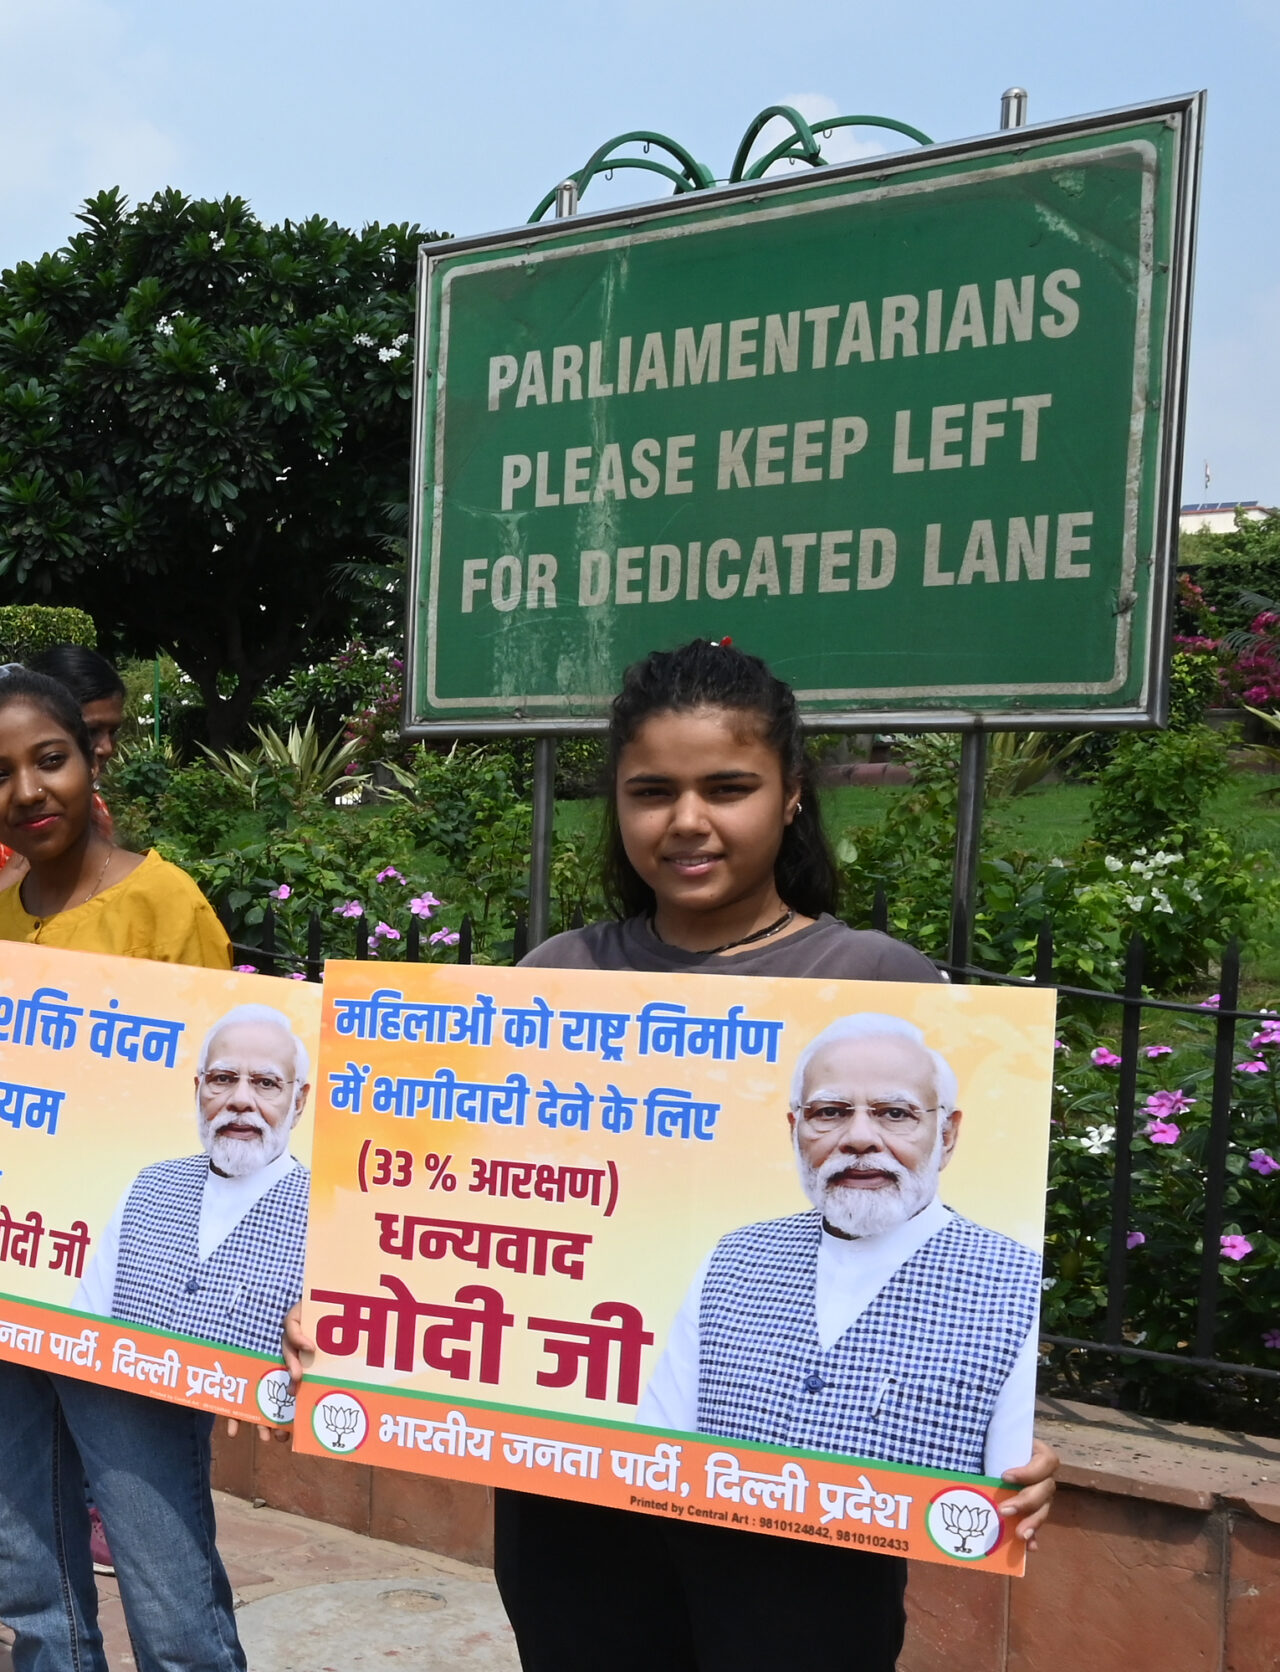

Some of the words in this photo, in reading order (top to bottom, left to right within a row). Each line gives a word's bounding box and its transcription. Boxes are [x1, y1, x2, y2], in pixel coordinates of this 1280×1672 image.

[488, 267, 1081, 411] PARLIAMENTARIANS
[500, 433, 696, 511] PLEASE
[716, 415, 869, 491] KEEP
[891, 393, 1052, 474] LEFT
[461, 554, 558, 613] FOR
[577, 527, 897, 607] DEDICATED
[922, 511, 1094, 587] LANE
[89, 998, 185, 1069] वंदन
[334, 990, 496, 1047] महिलाओं
[502, 995, 556, 1051] को
[561, 1009, 633, 1062] राष्ट्र
[636, 1001, 783, 1063] निर्माण
[328, 1063, 371, 1113] में
[372, 1068, 529, 1128] भागीदारी
[536, 1081, 594, 1134] देने
[601, 1092, 639, 1134] के
[643, 1088, 721, 1142] लिए
[356, 1140, 413, 1194] (33
[424, 1155, 457, 1192] %
[467, 1160, 621, 1217] आरक्षण)
[48, 1220, 90, 1278] जी
[375, 1211, 592, 1281] धन्यवाद
[49, 1326, 103, 1371] पार्टी,
[112, 1339, 181, 1387] दिल्ली
[185, 1361, 248, 1405] प्रदेश
[311, 1275, 516, 1385] मोदी
[528, 1301, 654, 1406] जी
[378, 1410, 494, 1462] भारतीय
[502, 1433, 602, 1480] जनता
[610, 1444, 691, 1498] पार्टी,
[705, 1459, 810, 1515] दिल्ली
[818, 1474, 911, 1531] प्रदेश
[630, 1495, 669, 1511] Printed
[671, 1504, 684, 1516] by
[687, 1505, 728, 1521] Central
[731, 1511, 749, 1525] Art
[836, 1528, 910, 1551] 9810102433
